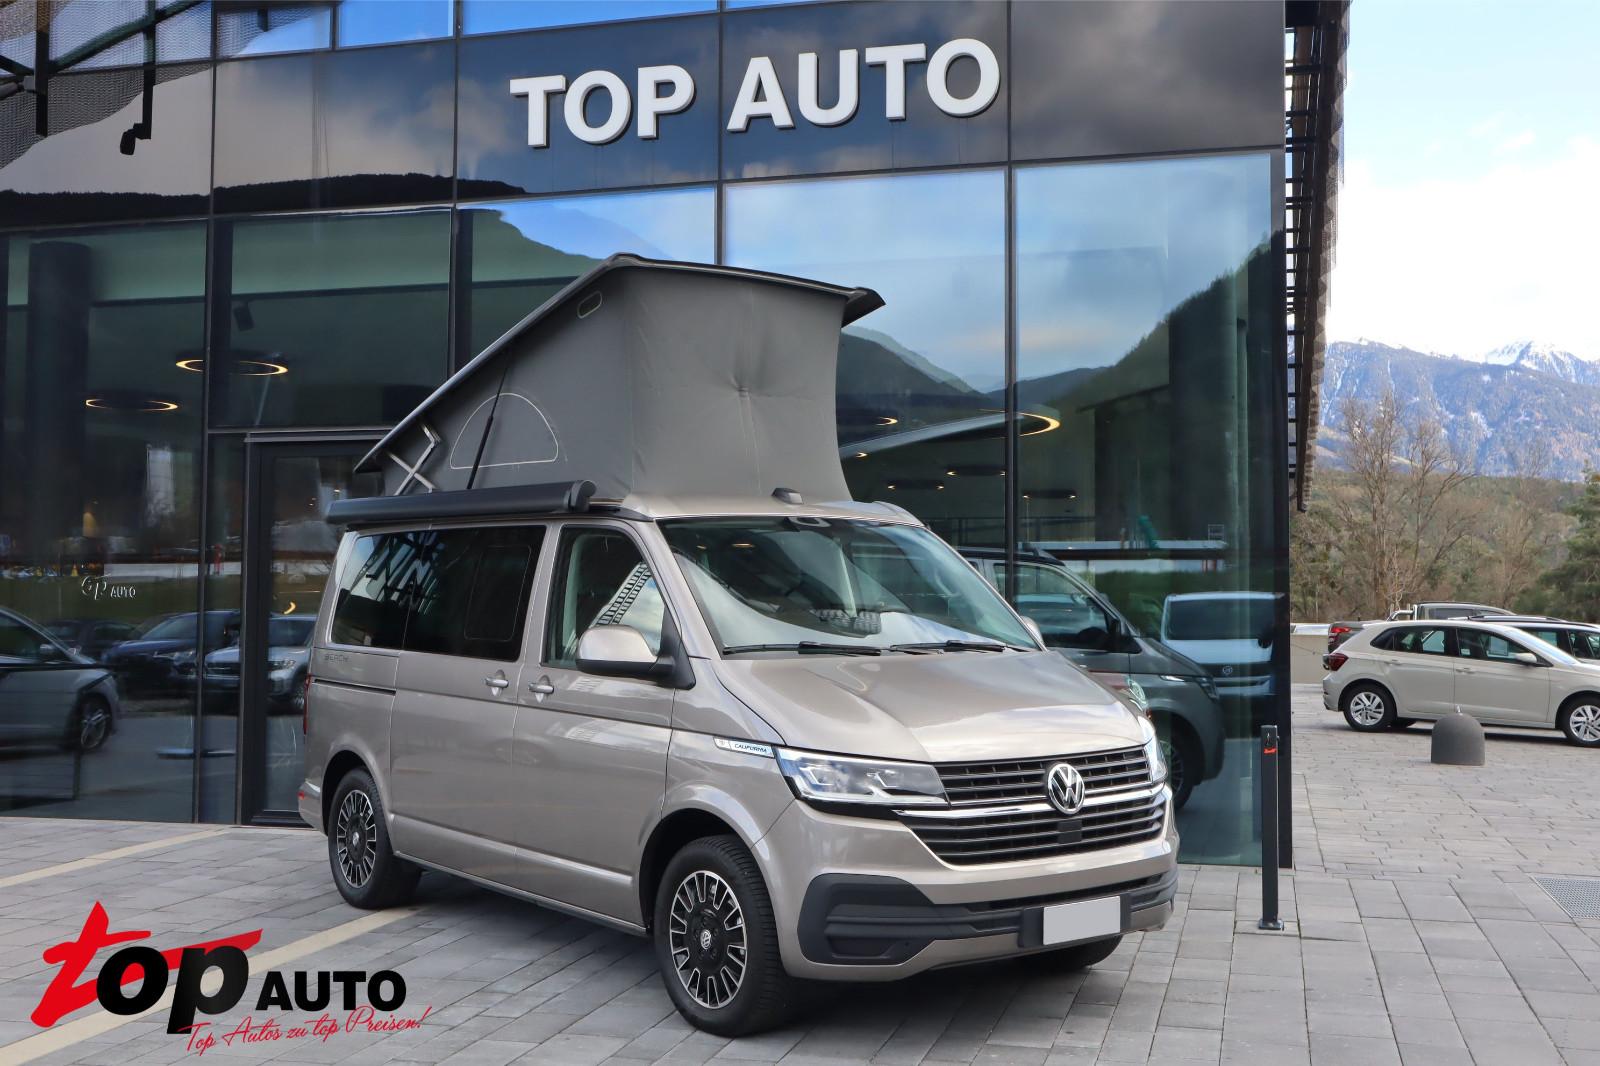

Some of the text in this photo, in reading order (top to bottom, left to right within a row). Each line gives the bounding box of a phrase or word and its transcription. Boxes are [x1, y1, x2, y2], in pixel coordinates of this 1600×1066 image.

[509, 38, 1000, 148] TOP AUTO
[110, 585, 136, 598] AUTO
